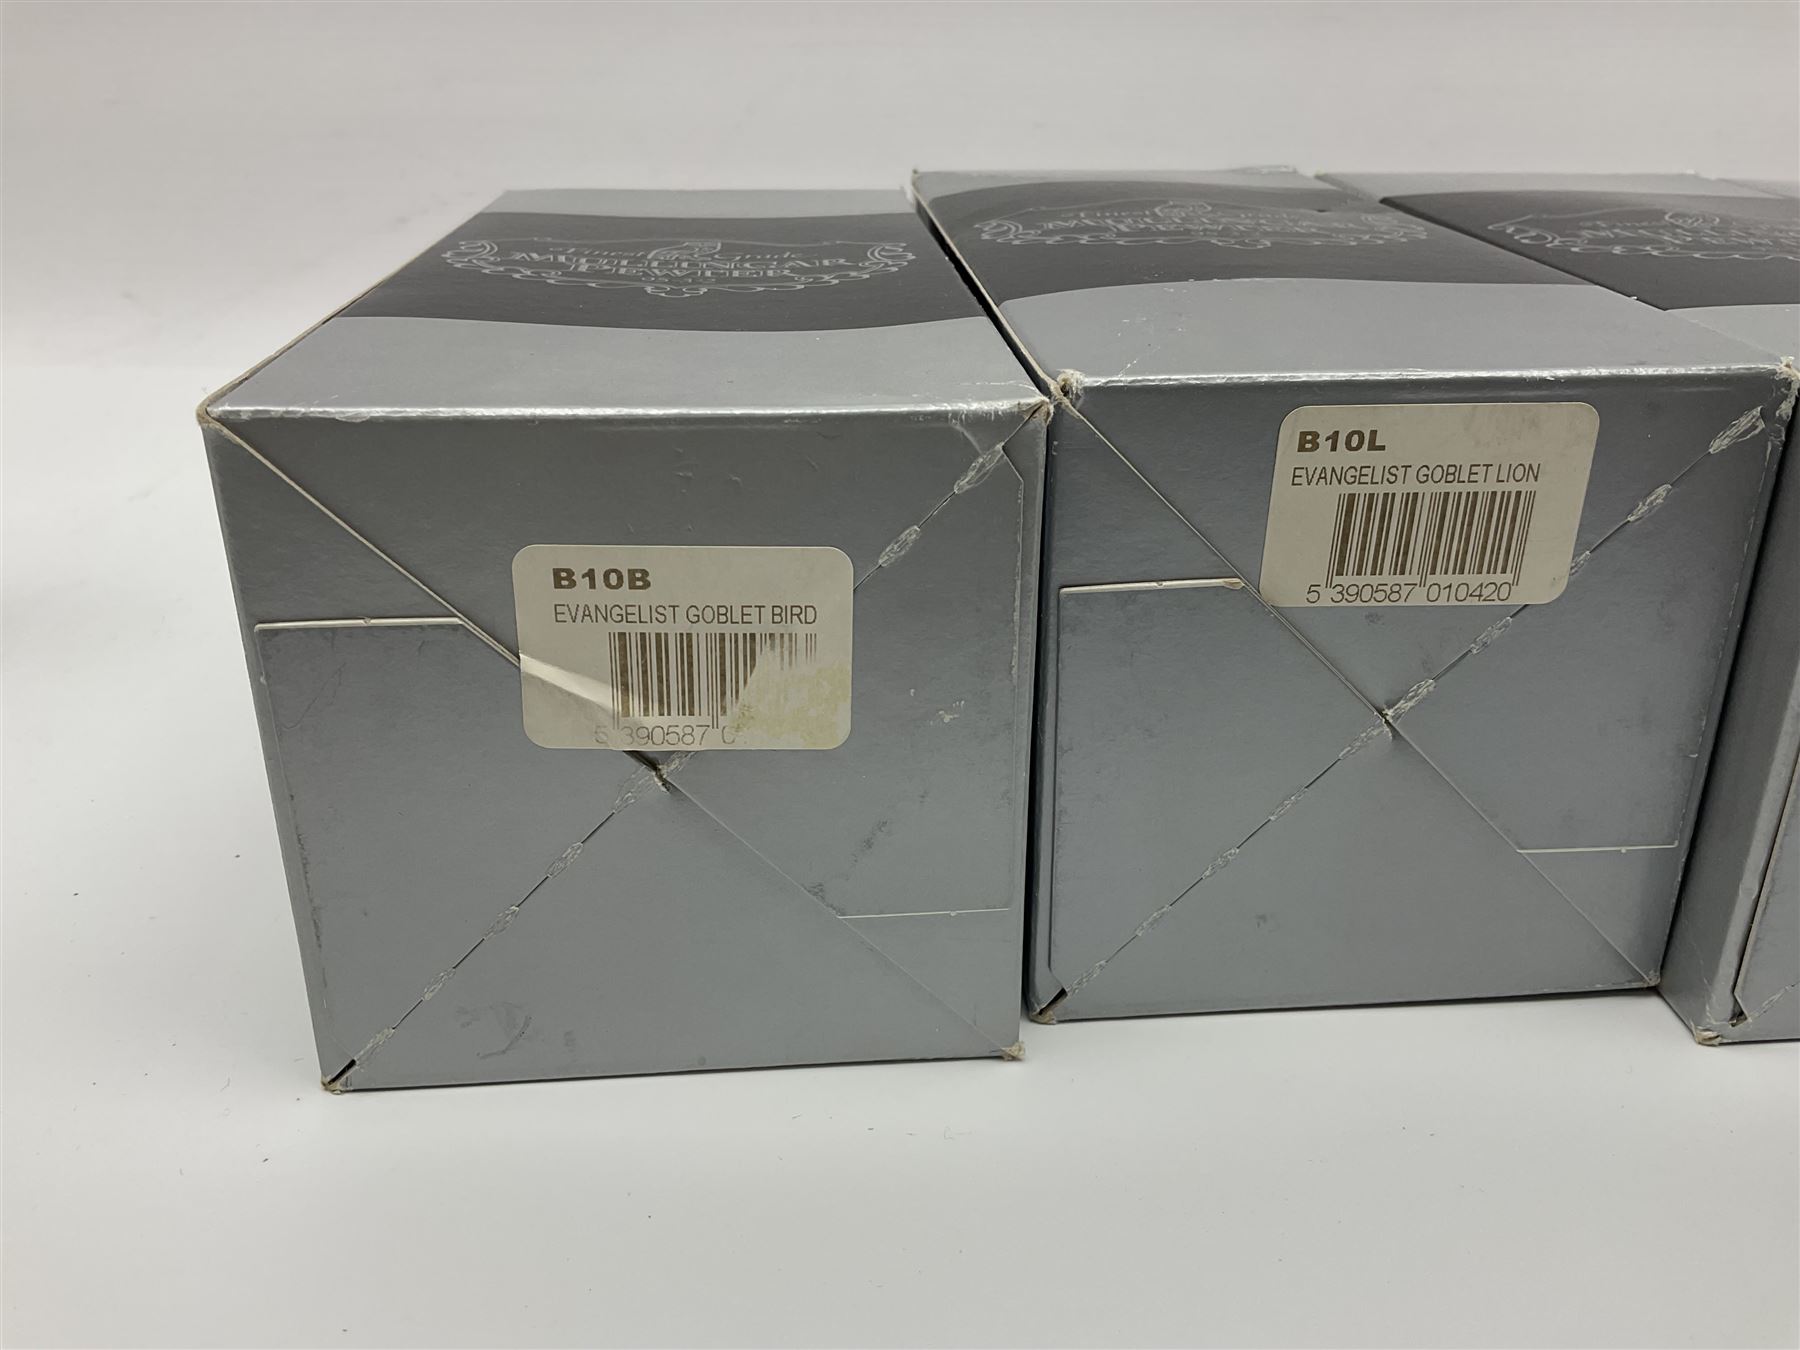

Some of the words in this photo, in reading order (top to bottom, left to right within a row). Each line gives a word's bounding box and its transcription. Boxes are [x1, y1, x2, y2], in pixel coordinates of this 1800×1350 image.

[511, 251, 857, 269] MULLINGAR
[568, 262, 801, 278] PEWTER
[1297, 430, 1386, 452] B10L
[1291, 465, 1412, 486] EVANGELIST
[1415, 464, 1493, 484] GOBLET
[1495, 463, 1541, 483] LION
[552, 567, 651, 590] B10B
[1306, 585, 1321, 604] 5
[1330, 583, 1417, 603] 390587
[1426, 582, 1512, 602] 010420
[554, 603, 678, 624] EVANGELIST
[686, 604, 765, 625] GOBLET
[771, 605, 818, 625] BIRD
[594, 725, 608, 744] 5
[620, 724, 711, 746] 390587
